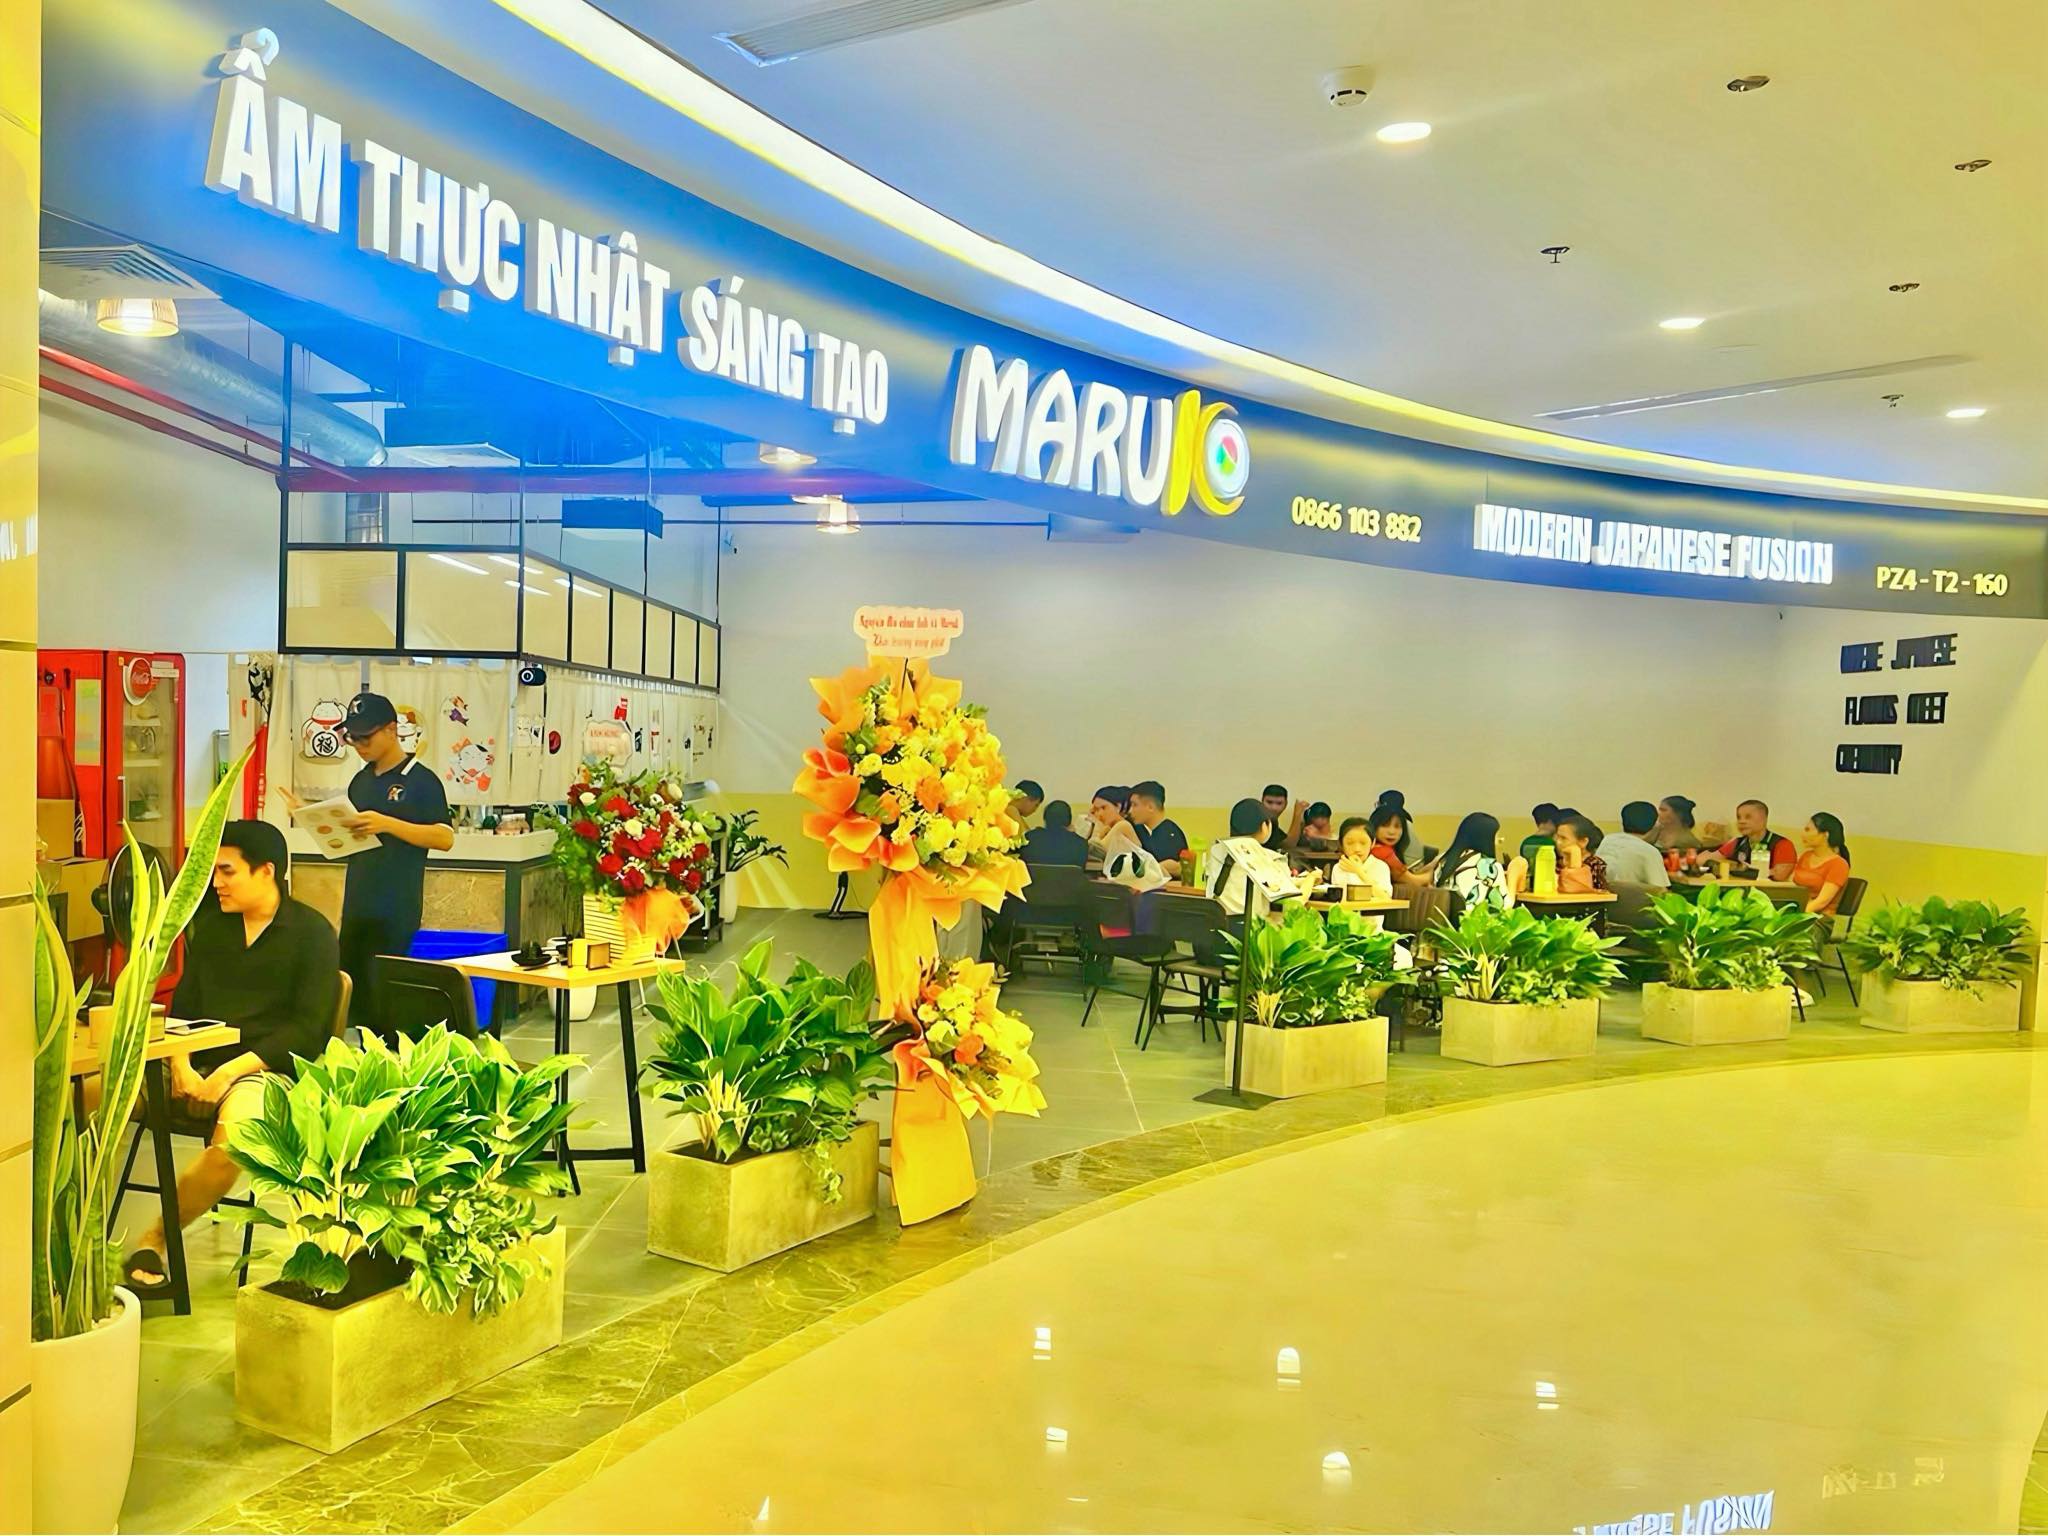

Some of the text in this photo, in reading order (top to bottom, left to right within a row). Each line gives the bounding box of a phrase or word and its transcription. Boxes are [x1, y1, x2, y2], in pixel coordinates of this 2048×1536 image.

[205, 26, 889, 435] ẨM THỰC NHẬT SÁNG TẠO
[950, 343, 1251, 517] MARUKO
[1291, 495, 1423, 543] 0866 103 882
[1473, 503, 1834, 585] MODERN JAPANESE FUSION
